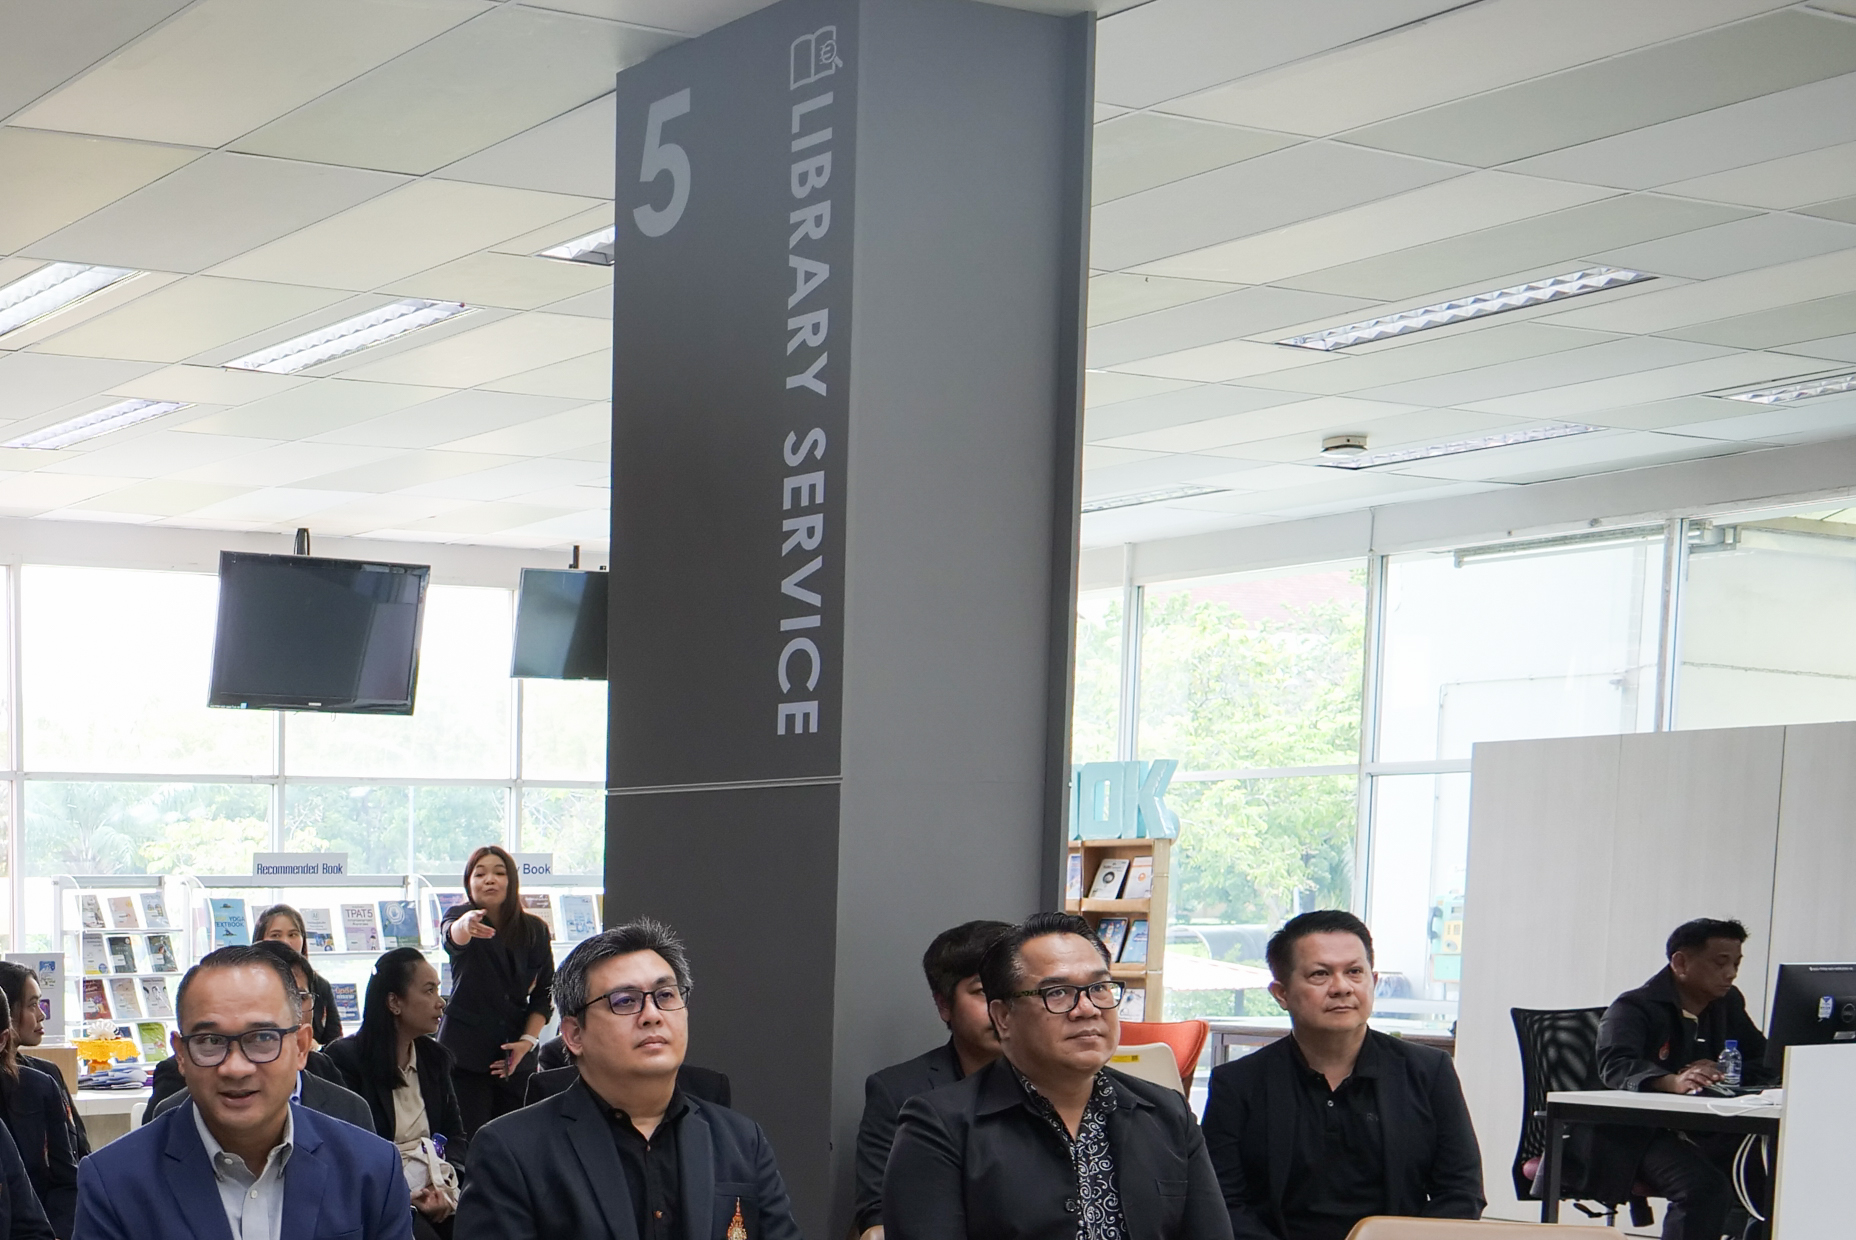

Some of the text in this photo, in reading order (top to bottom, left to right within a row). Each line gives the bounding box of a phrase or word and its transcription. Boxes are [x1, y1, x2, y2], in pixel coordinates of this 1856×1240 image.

[632, 87, 692, 238] 5
[776, 91, 834, 736] LIBRARY SERVICE
[1069, 758, 1179, 840] OK
[256, 862, 344, 875] Recommended Book
[522, 863, 551, 875] Book
